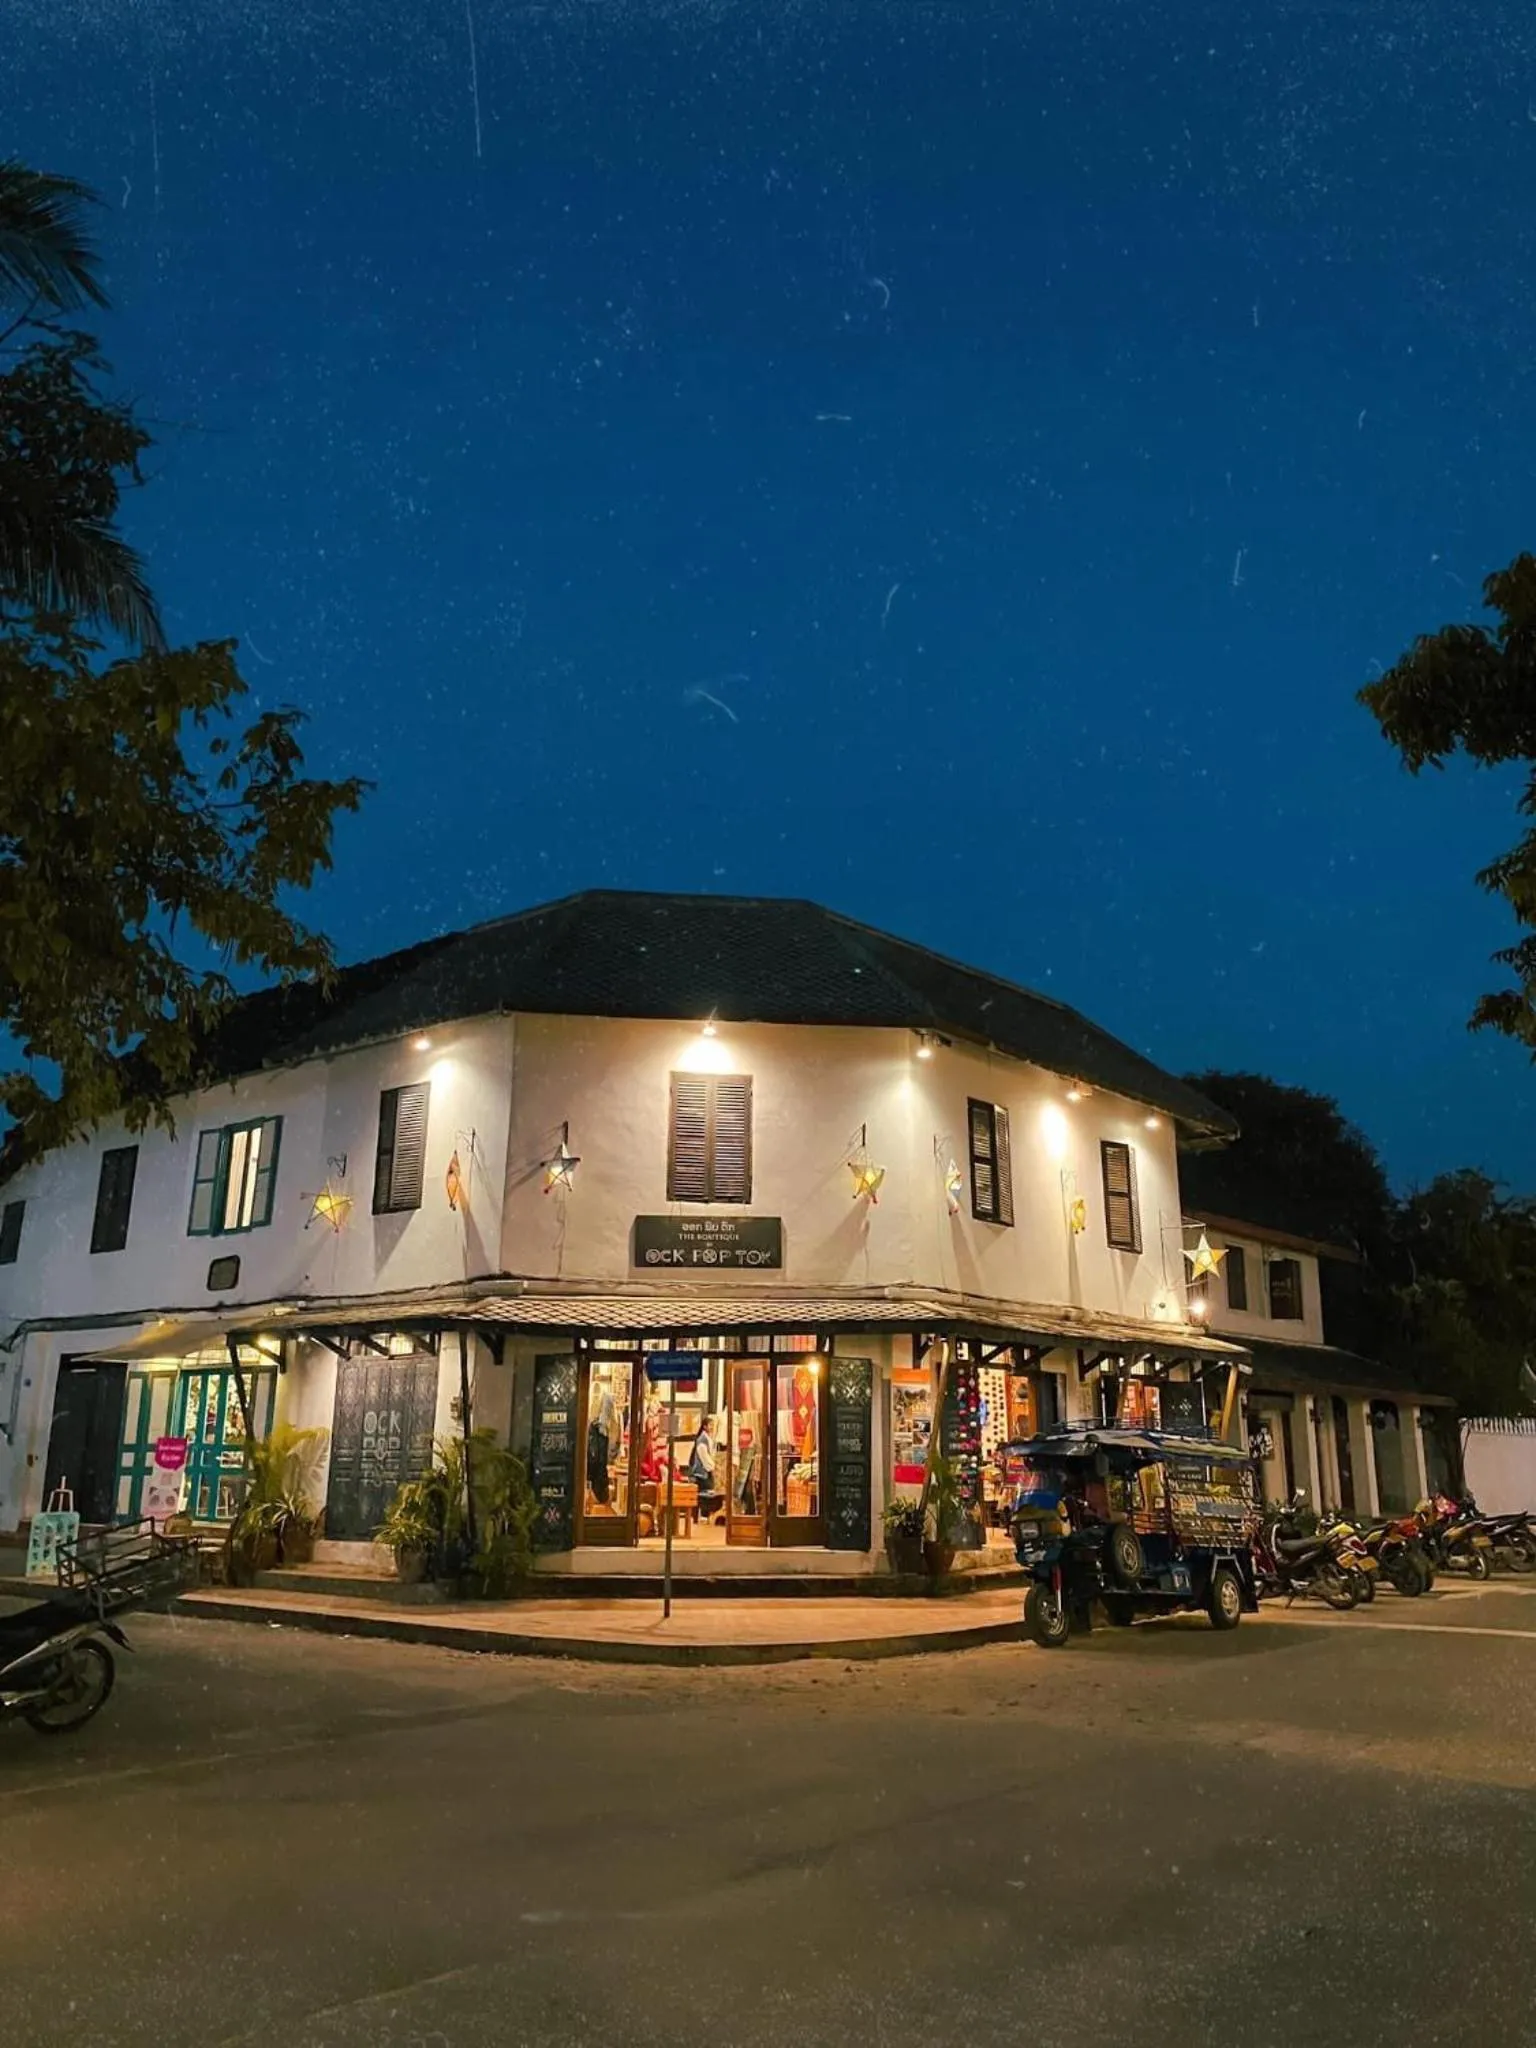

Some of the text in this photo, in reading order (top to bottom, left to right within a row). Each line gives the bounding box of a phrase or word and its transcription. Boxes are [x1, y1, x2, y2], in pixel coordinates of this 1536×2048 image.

[679, 1233, 739, 1241] THE BOUTIQUE
[645, 1248, 685, 1264] OCK
[735, 1249, 772, 1265] TOK
[365, 1410, 401, 1434] OCK
